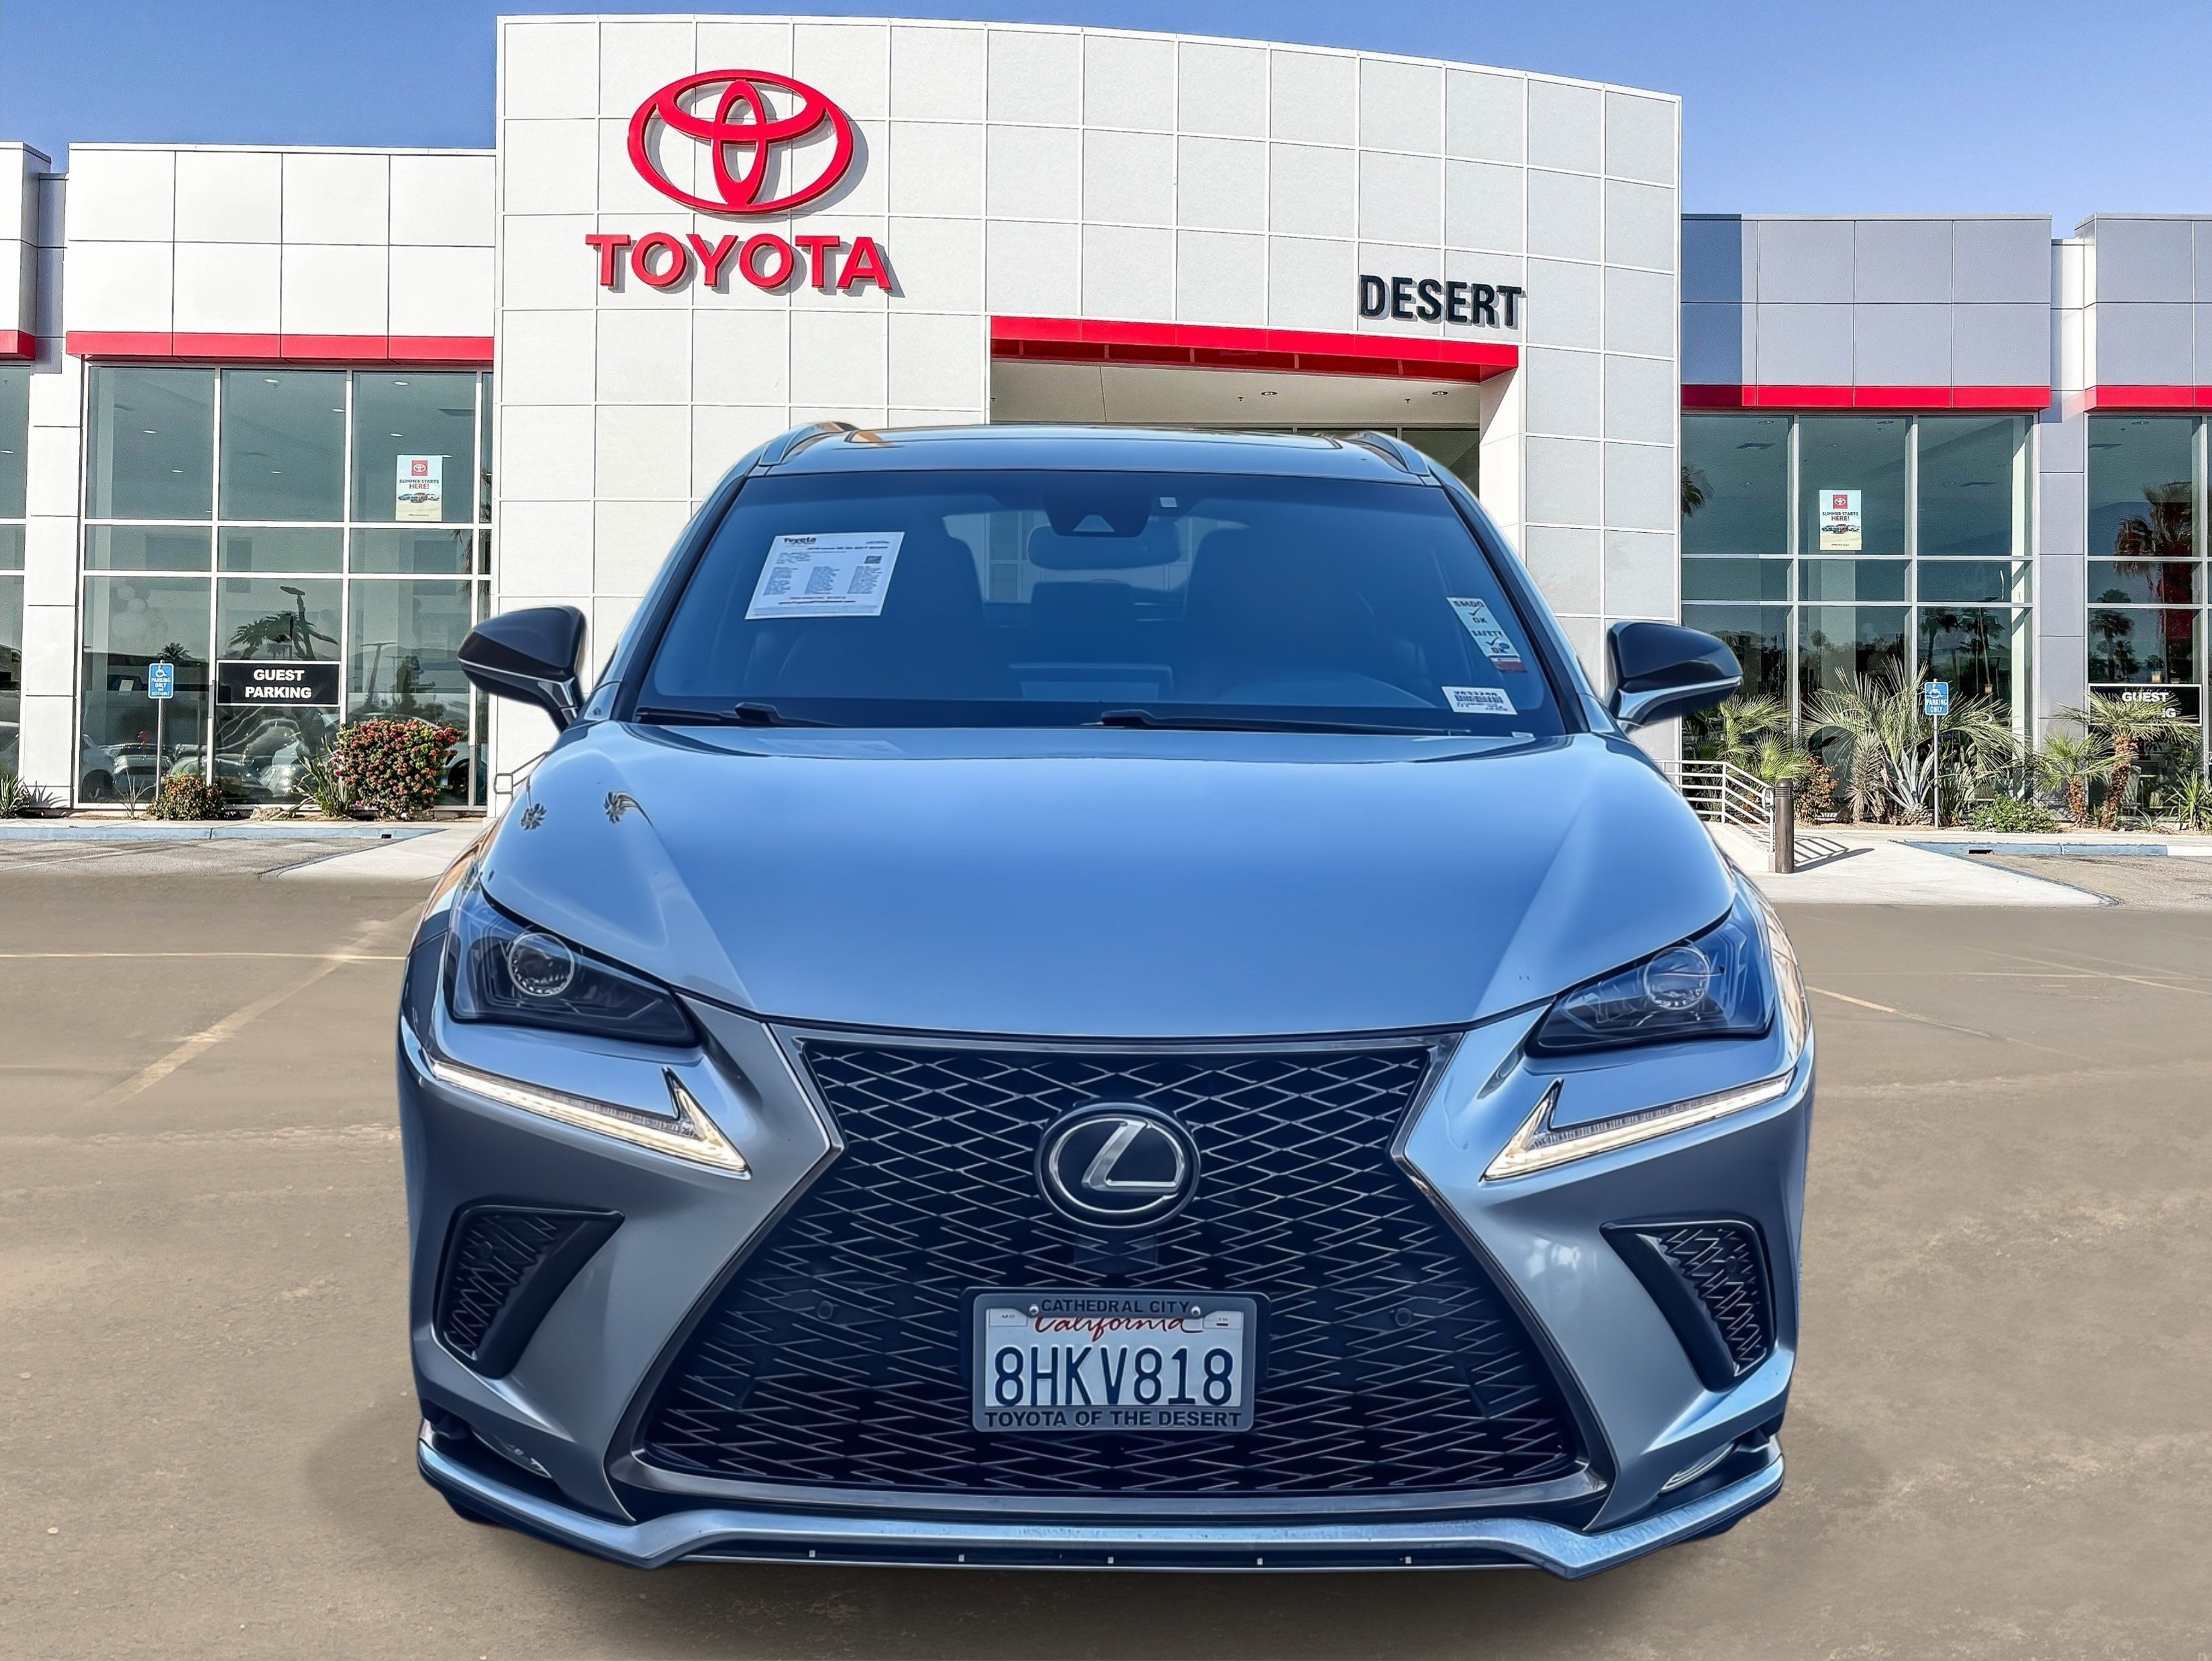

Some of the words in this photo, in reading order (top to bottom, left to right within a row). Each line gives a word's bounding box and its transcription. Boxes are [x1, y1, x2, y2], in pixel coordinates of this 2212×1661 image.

[585, 232, 892, 290] TOYOTA
[1359, 274, 1521, 326] DESERT
[253, 668, 305, 681] GUEST
[245, 686, 312, 699] PARKING
[2121, 691, 2170, 703] GUEST
[1041, 1299, 1144, 1313] CATHEDRAL
[1149, 1300, 1191, 1313] CITY
[994, 1346, 1234, 1407] 8HKV818
[984, 1411, 1067, 1427] TOYOTA
[1075, 1411, 1103, 1427] OF
[1109, 1411, 1152, 1426] THE
[1158, 1411, 1242, 1427] DESERT
